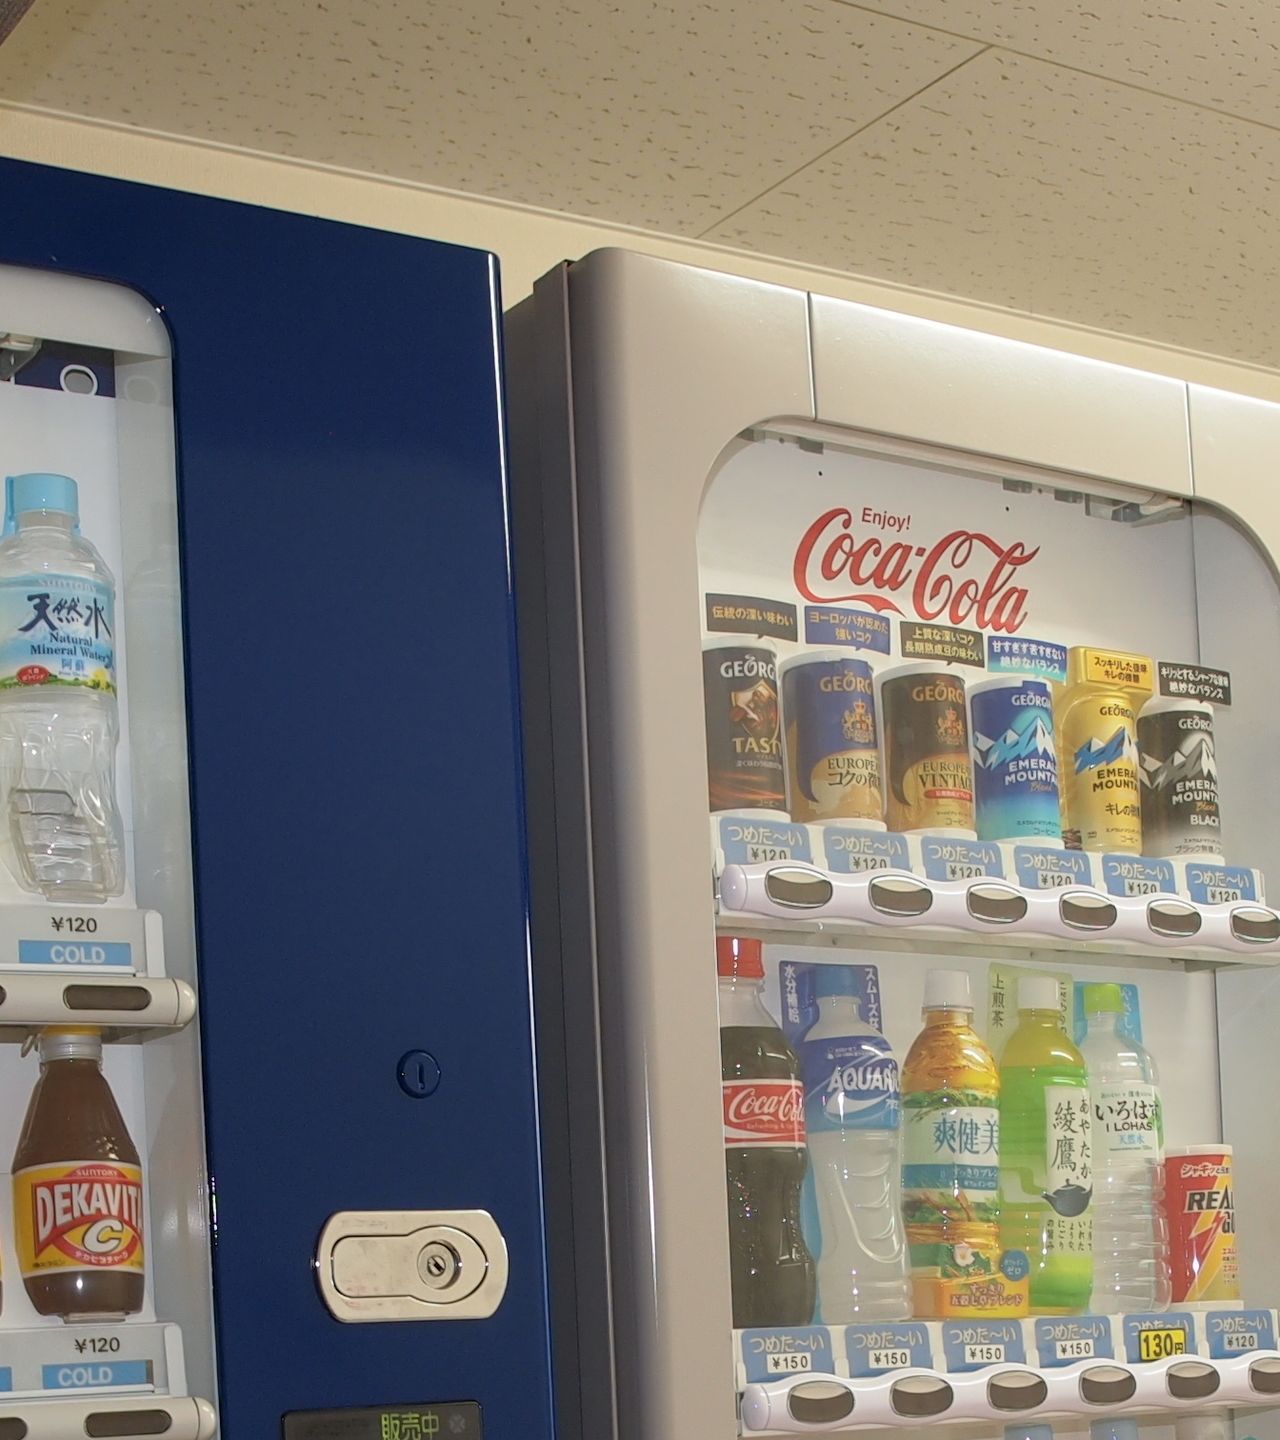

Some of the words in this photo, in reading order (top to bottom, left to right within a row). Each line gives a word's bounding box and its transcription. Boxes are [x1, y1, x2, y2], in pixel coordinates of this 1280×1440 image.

[862, 508, 911, 532] Enjoy!
[793, 507, 1040, 634] Coca-Cola
[19, 593, 112, 639] 天然水
[713, 605, 793, 626] 伝統の深い味わい
[49, 632, 93, 647] Natural
[835, 628, 871, 644] 強いコク
[912, 626, 974, 645] 上質な深いコク
[30, 644, 78, 657] Mineral
[1000, 657, 1060, 674] 絶妙なバランス
[1094, 657, 1147, 673] スッキリした後味
[1104, 670, 1140, 684] キレの微糖
[1169, 683, 1224, 699] 絶妙なバランス
[52, 916, 98, 934] ¥120
[50, 944, 105, 962] COLD
[991, 973, 1005, 1029] 上煎茶
[1052, 1100, 1078, 1172] 綾鷹
[1114, 1122, 1153, 1133] LOHAS
[76, 1168, 118, 1177] SUNTORY
[82, 1219, 124, 1253] C
[74, 1337, 120, 1354] ¥120
[969, 1346, 1002, 1361] ¥150
[1060, 1342, 1091, 1355] ¥150
[772, 1355, 808, 1370] ¥150
[873, 1351, 907, 1366] ¥150
[58, 1368, 113, 1386] COLD
